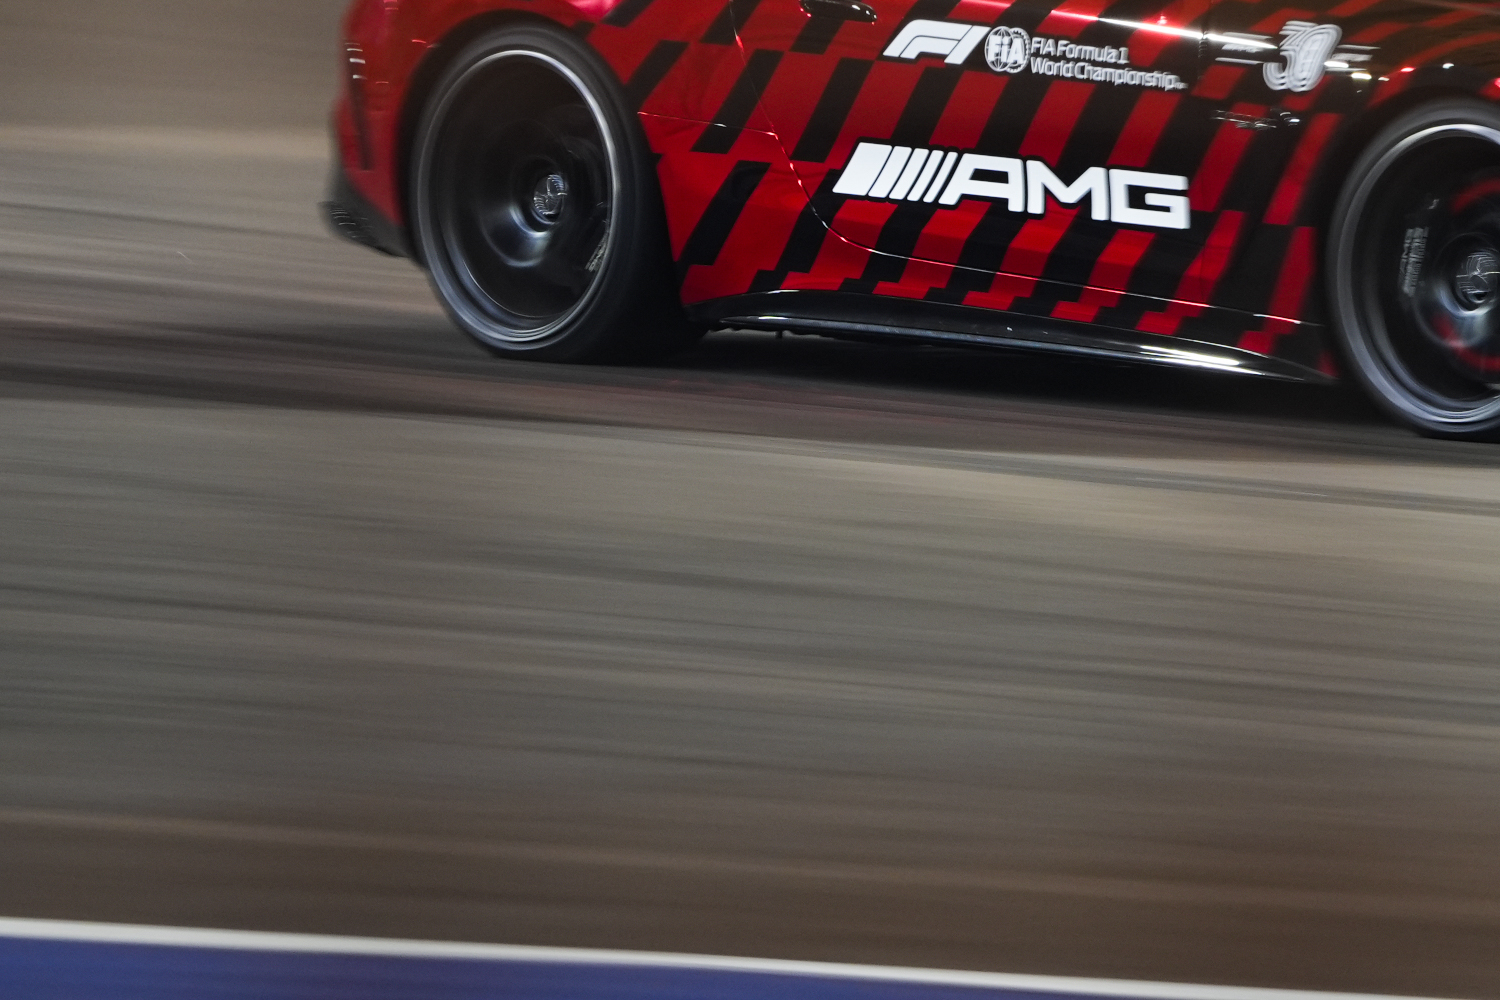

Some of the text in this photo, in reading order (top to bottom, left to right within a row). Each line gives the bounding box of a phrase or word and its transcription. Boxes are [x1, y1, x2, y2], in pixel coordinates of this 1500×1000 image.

[883, 19, 992, 65] F1
[1031, 36, 1057, 57] FIA
[1056, 39, 1121, 63] Formula
[1030, 56, 1181, 92] World Championship
[938, 152, 1191, 230] AMG
